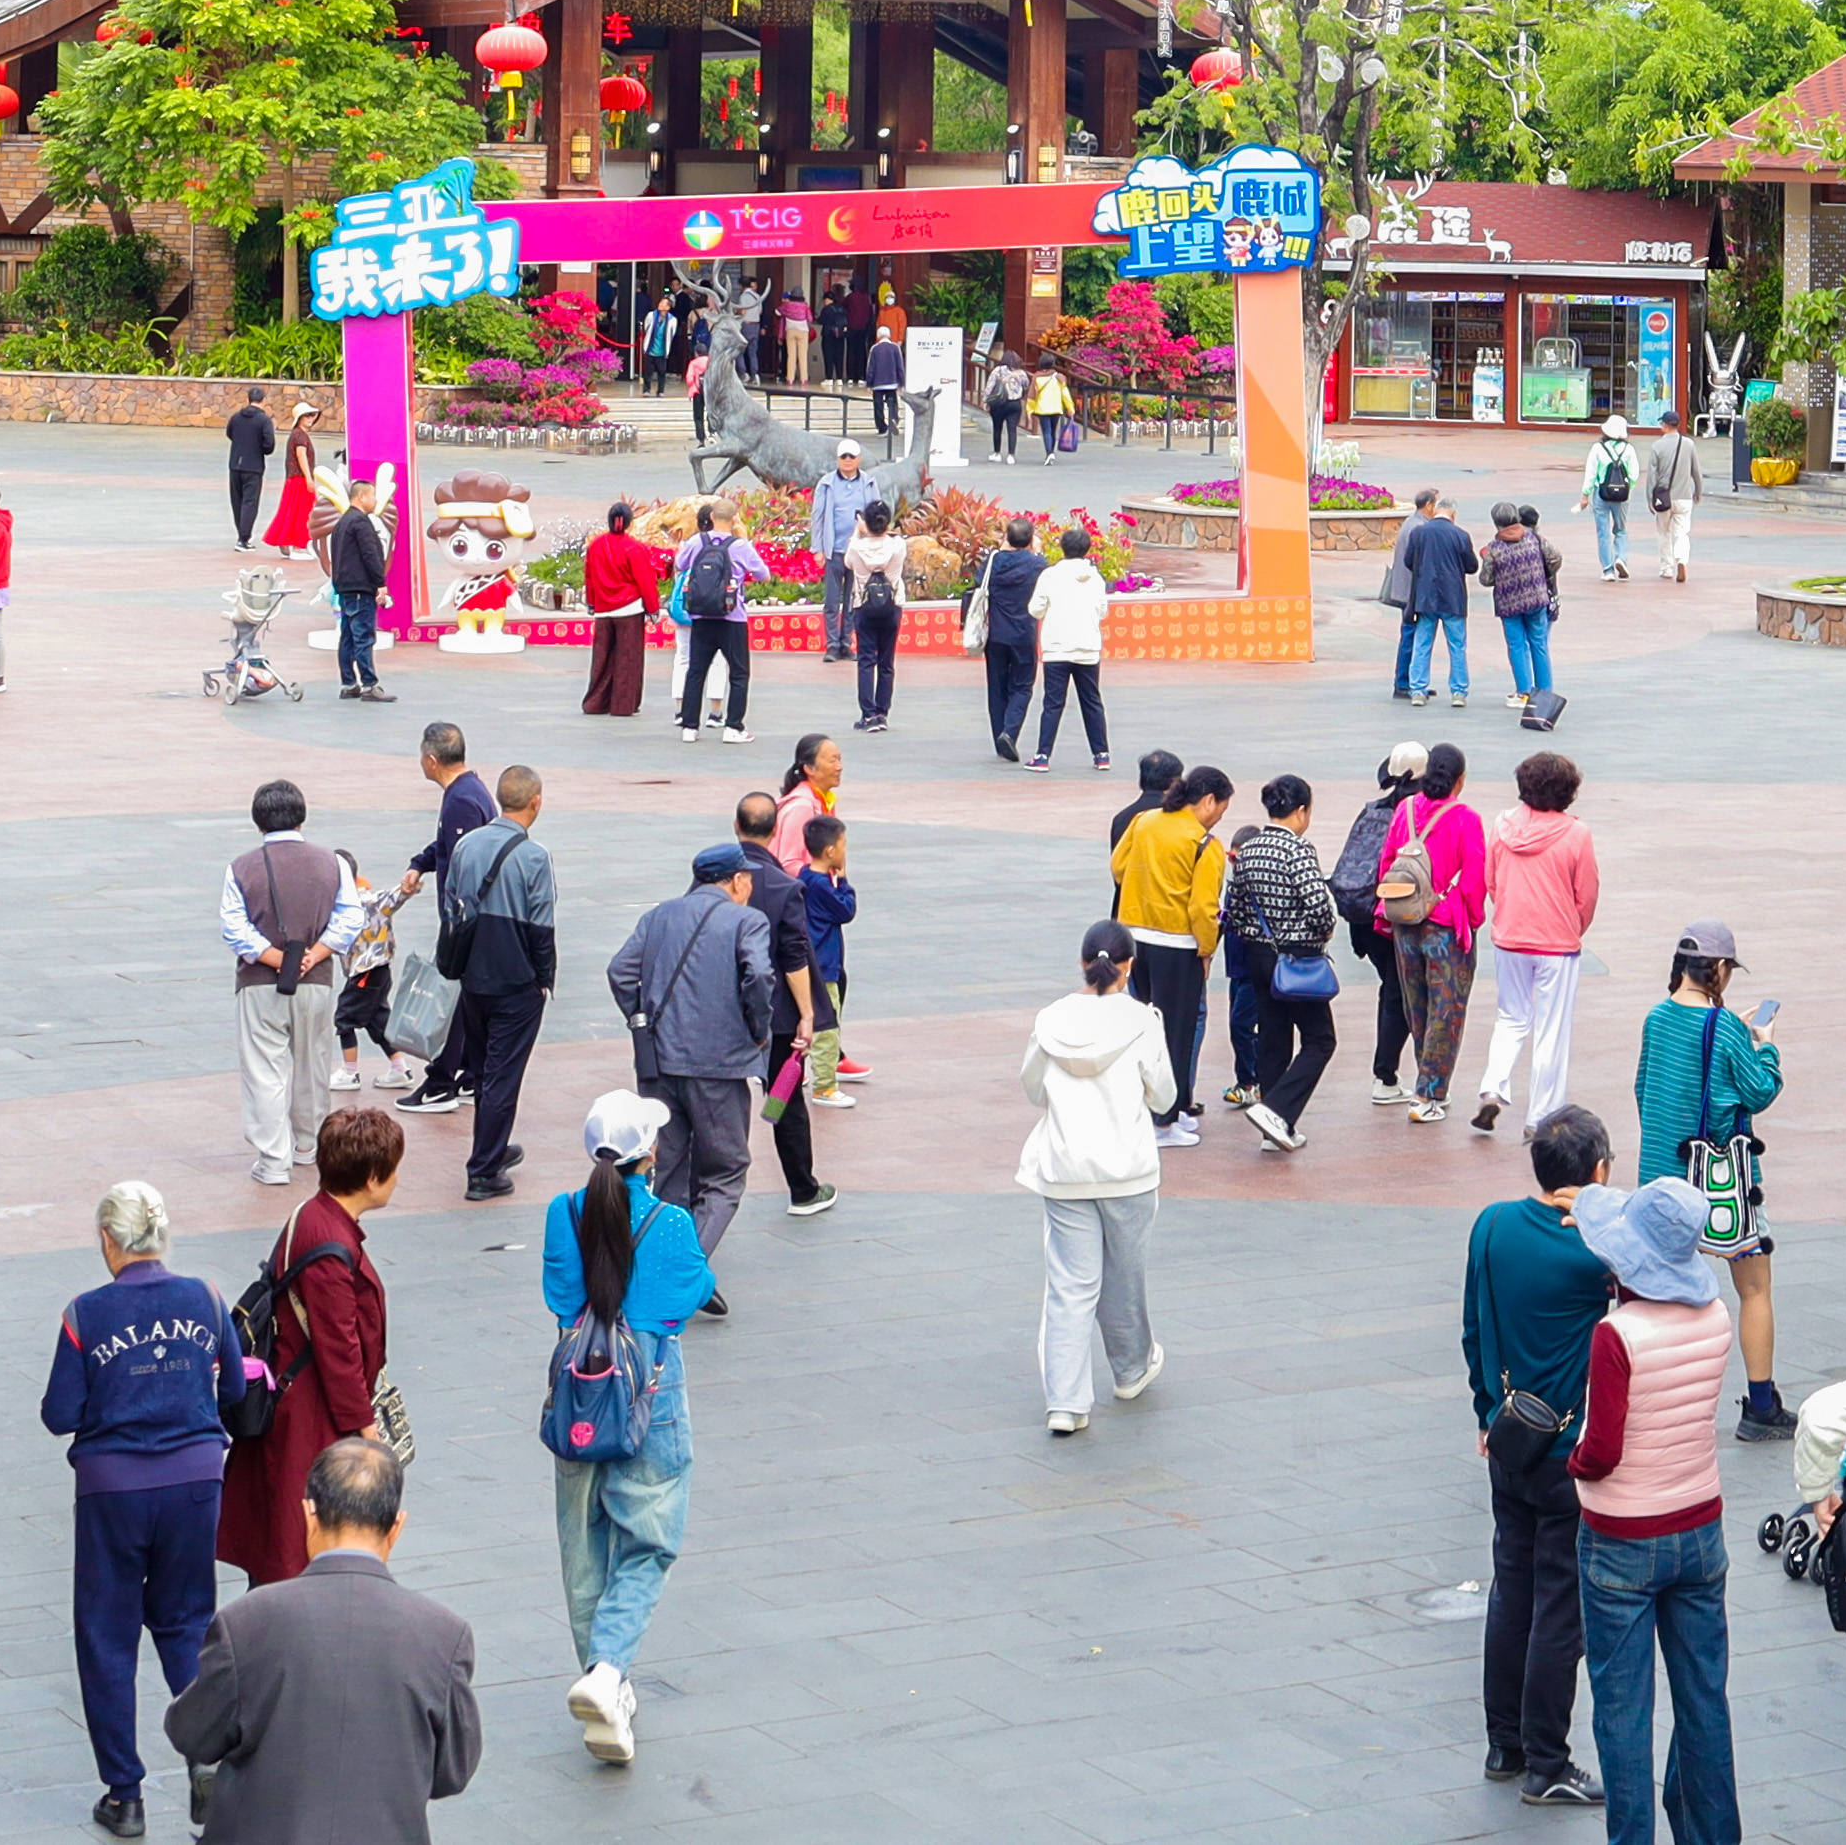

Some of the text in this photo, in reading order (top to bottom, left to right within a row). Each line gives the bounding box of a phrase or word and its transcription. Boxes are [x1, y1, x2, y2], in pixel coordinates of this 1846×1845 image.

[603, 11, 634, 44] 车
[339, 184, 479, 244] 三亚
[1117, 183, 1220, 229] 鹿回头
[1232, 178, 1308, 217] 鹿城
[1125, 220, 1217, 270] 上望
[1626, 240, 1693, 262] 便利店
[90, 1318, 220, 1367] BALANCE
